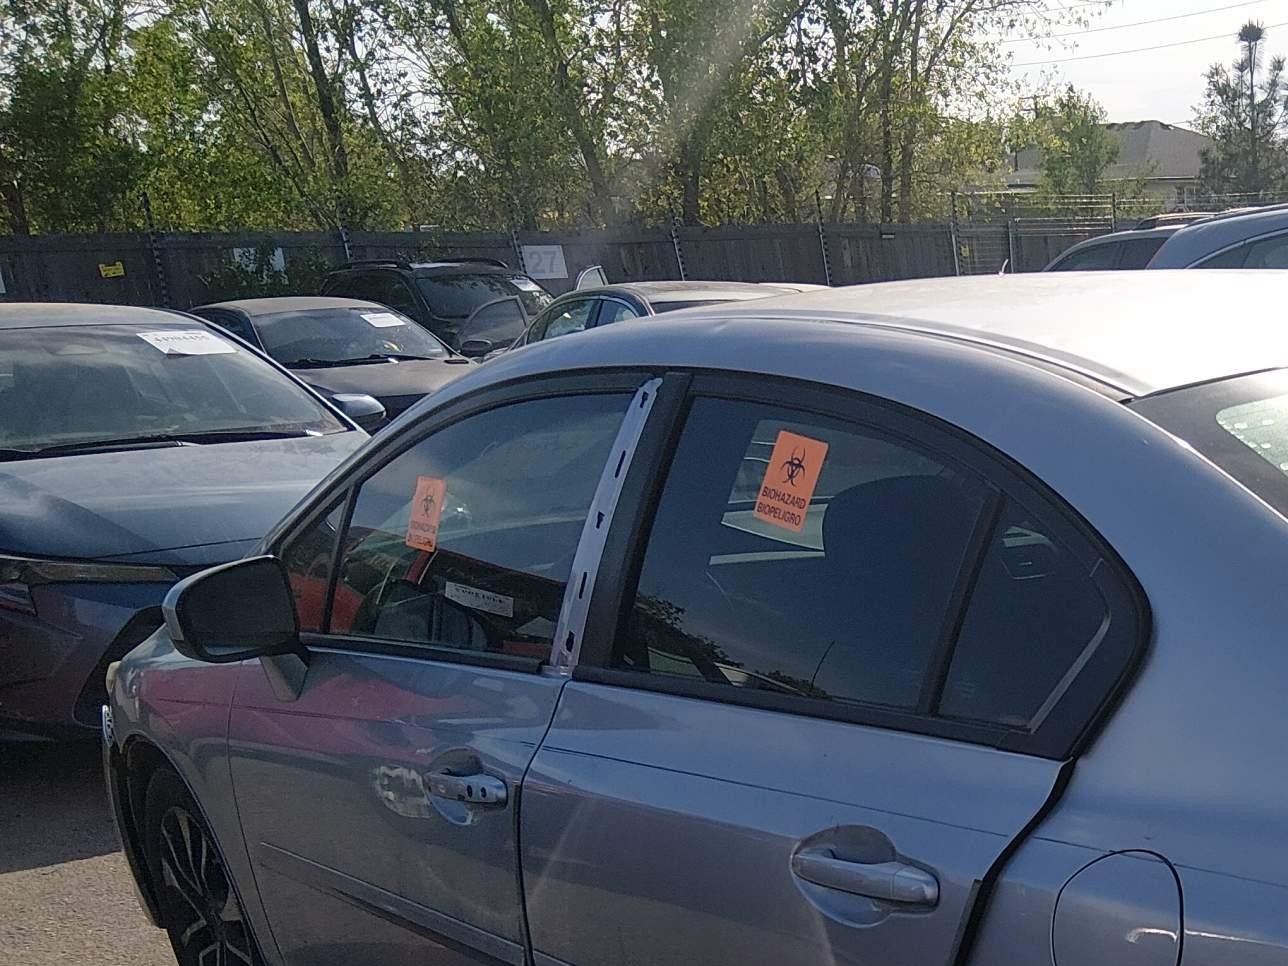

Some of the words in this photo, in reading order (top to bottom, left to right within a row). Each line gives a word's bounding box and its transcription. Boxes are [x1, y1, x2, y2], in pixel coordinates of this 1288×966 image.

[530, 250, 557, 274] 27
[762, 486, 807, 510] BIOHAZARD
[757, 502, 801, 526] BIOPELIGRO
